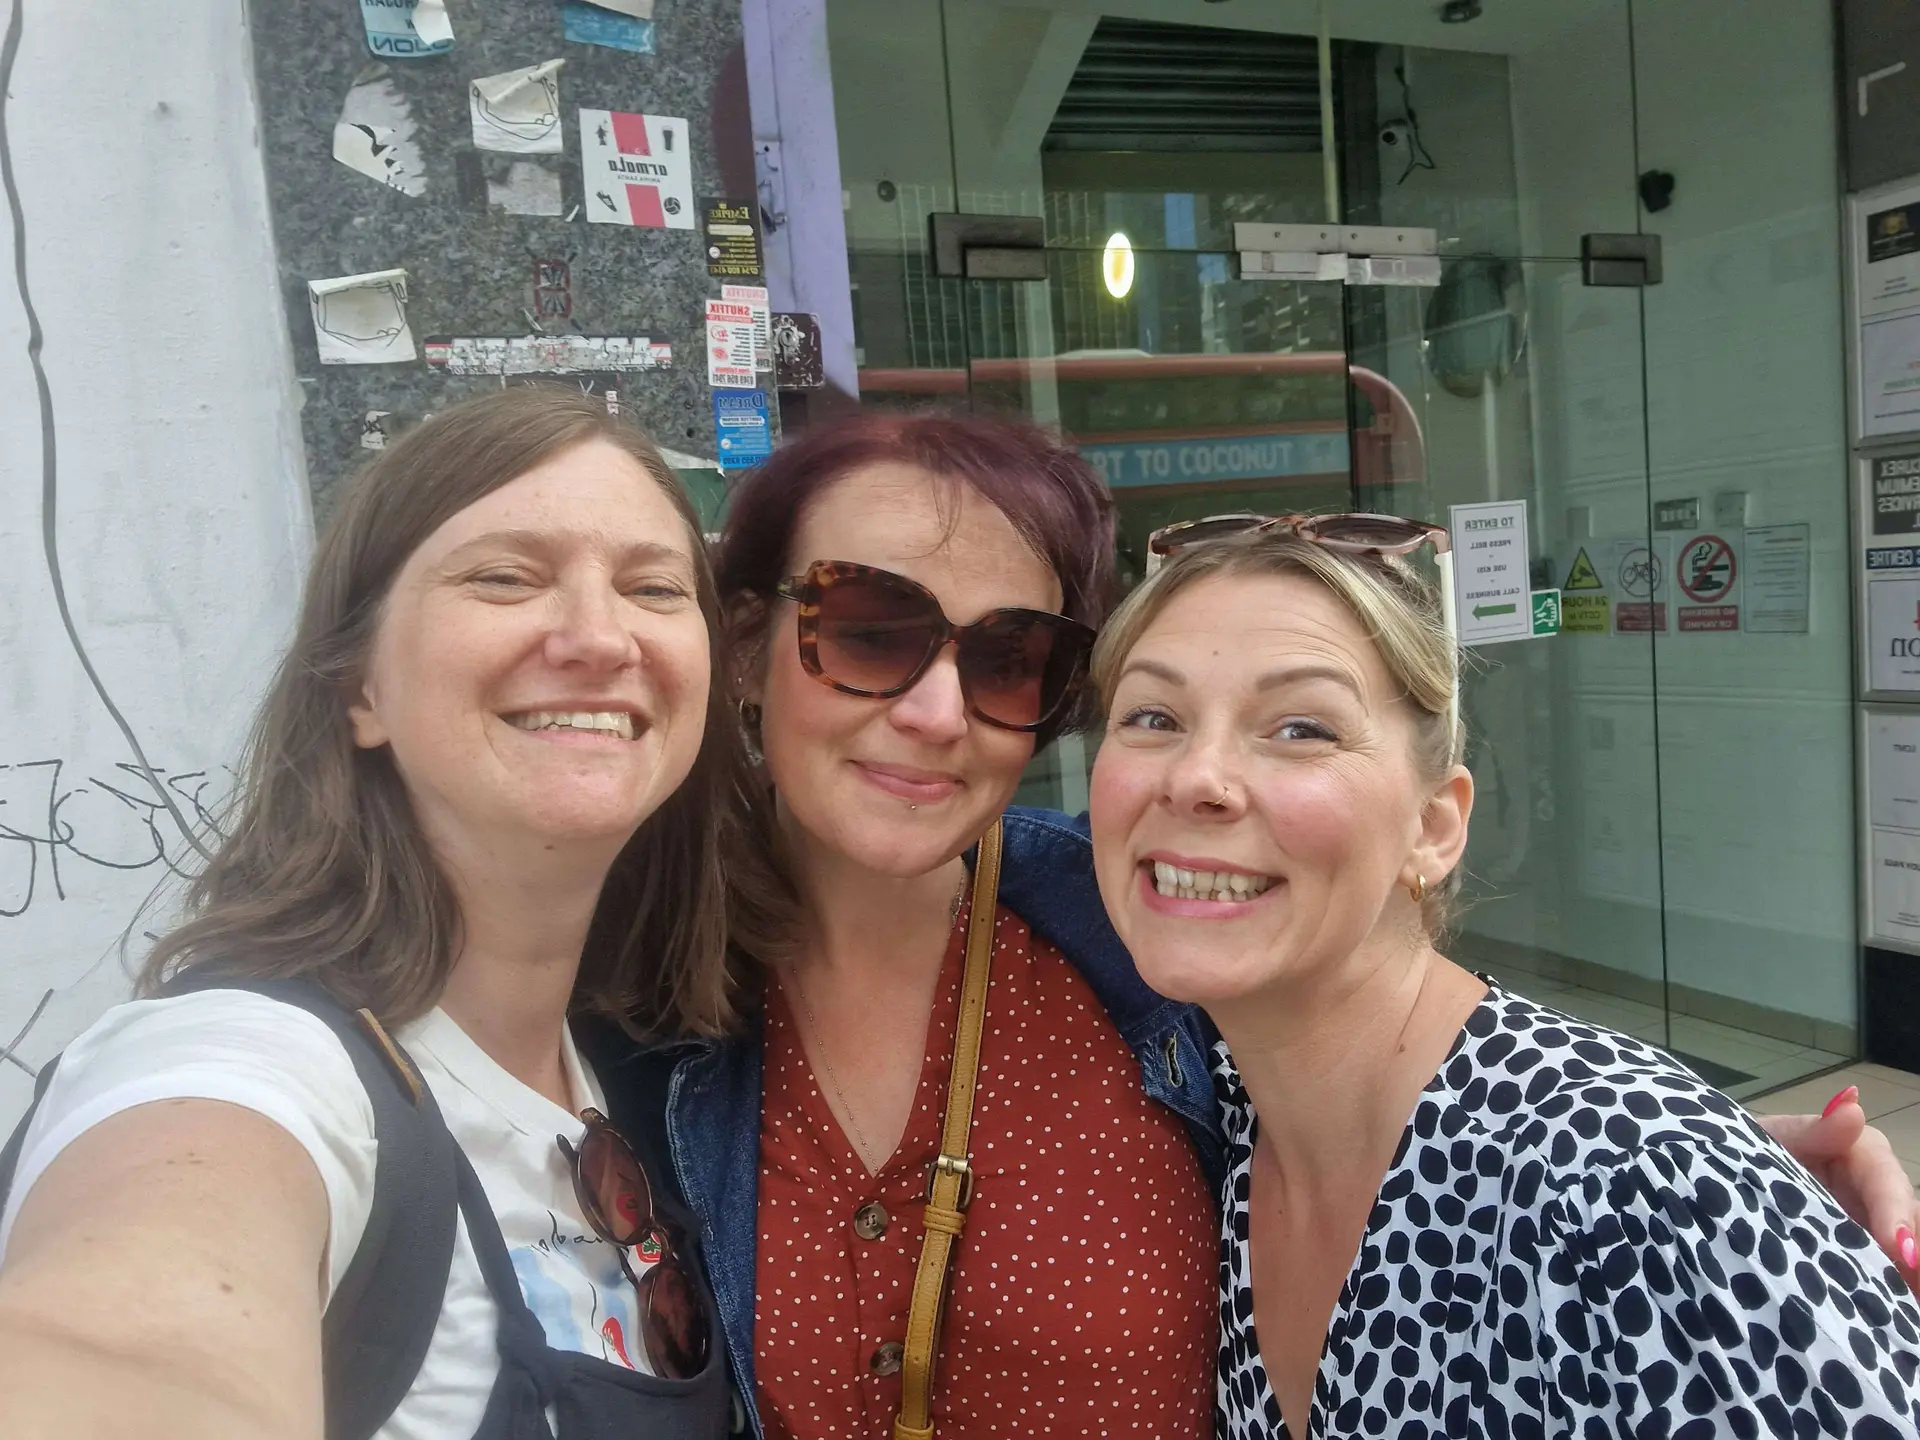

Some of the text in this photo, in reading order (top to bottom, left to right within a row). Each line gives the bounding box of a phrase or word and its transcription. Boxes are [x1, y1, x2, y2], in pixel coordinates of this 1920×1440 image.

[1082, 441, 1293, 479] RT TO COCONUT
